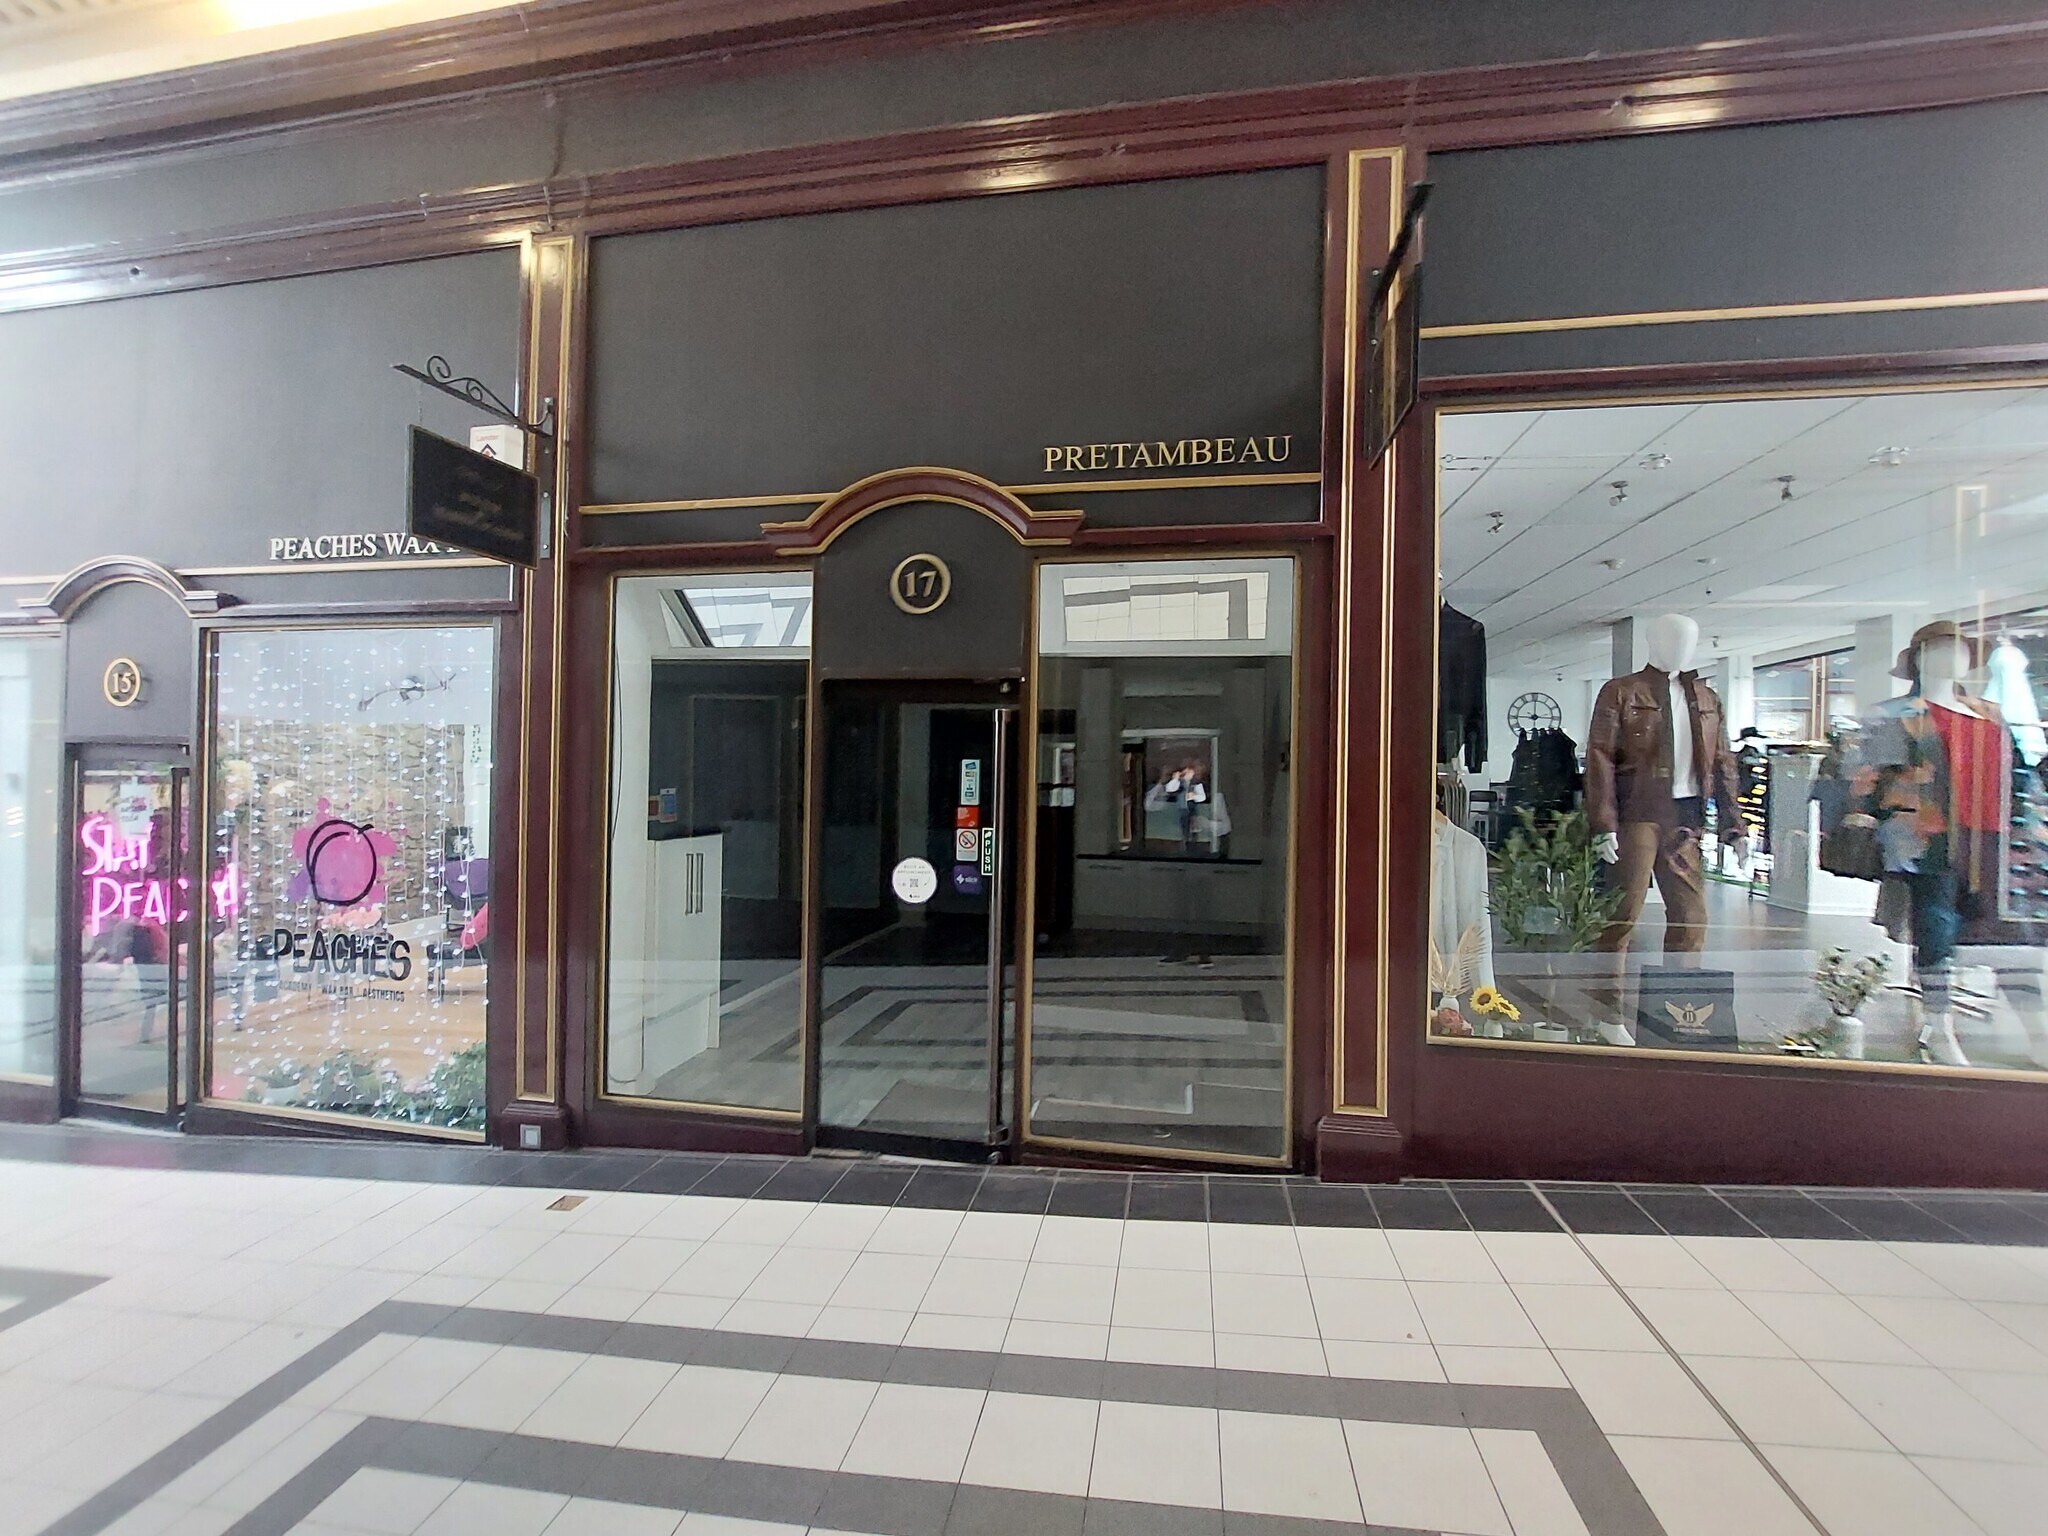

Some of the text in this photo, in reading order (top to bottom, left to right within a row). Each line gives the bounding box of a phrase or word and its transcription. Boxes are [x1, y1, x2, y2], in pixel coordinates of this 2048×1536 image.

[1043, 435, 1292, 472] PRETAMBEAU
[270, 533, 377, 560] PEACHES
[904, 570, 937, 598] 17
[112, 672, 132, 693] 15
[274, 929, 411, 981] PEACHES
